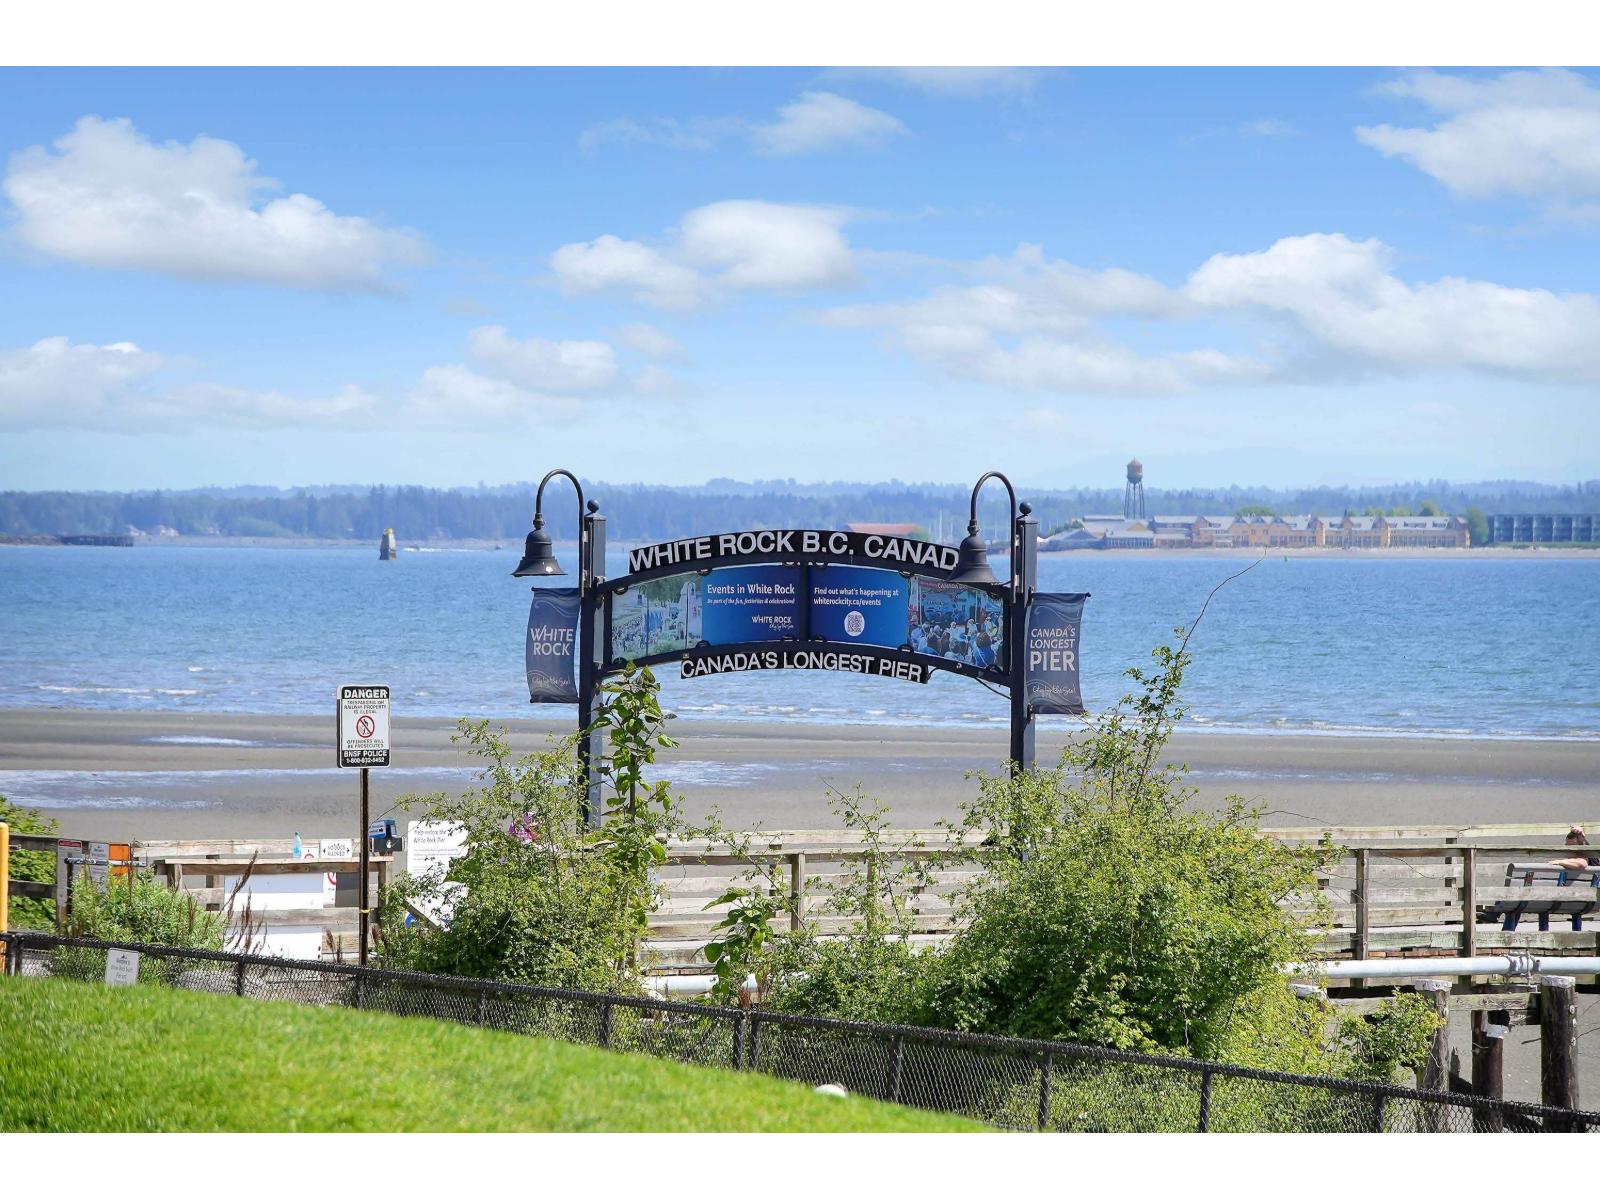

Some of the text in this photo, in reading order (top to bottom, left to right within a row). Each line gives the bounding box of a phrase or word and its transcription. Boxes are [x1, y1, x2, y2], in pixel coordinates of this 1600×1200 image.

[630, 531, 961, 572] WHITE ROCK B.C. CANAD
[707, 584, 795, 594] Events in White Rock
[814, 587, 827, 595] Find
[827, 588, 839, 596] out
[839, 587, 859, 596] what's
[859, 588, 892, 597] happening
[813, 597, 882, 606] whiterockcity.ca/events
[751, 614, 792, 624] WHITE ROCK
[530, 625, 574, 642] WHITE
[1031, 627, 1076, 638] CANADA'S
[533, 642, 570, 656] ROCK
[1030, 638, 1076, 649] LONGEST
[681, 651, 922, 683] CANADA'S LONGEST PIER
[1029, 651, 1076, 672] PIER
[344, 689, 387, 699] DANGER
[343, 750, 361, 758] BNSF
